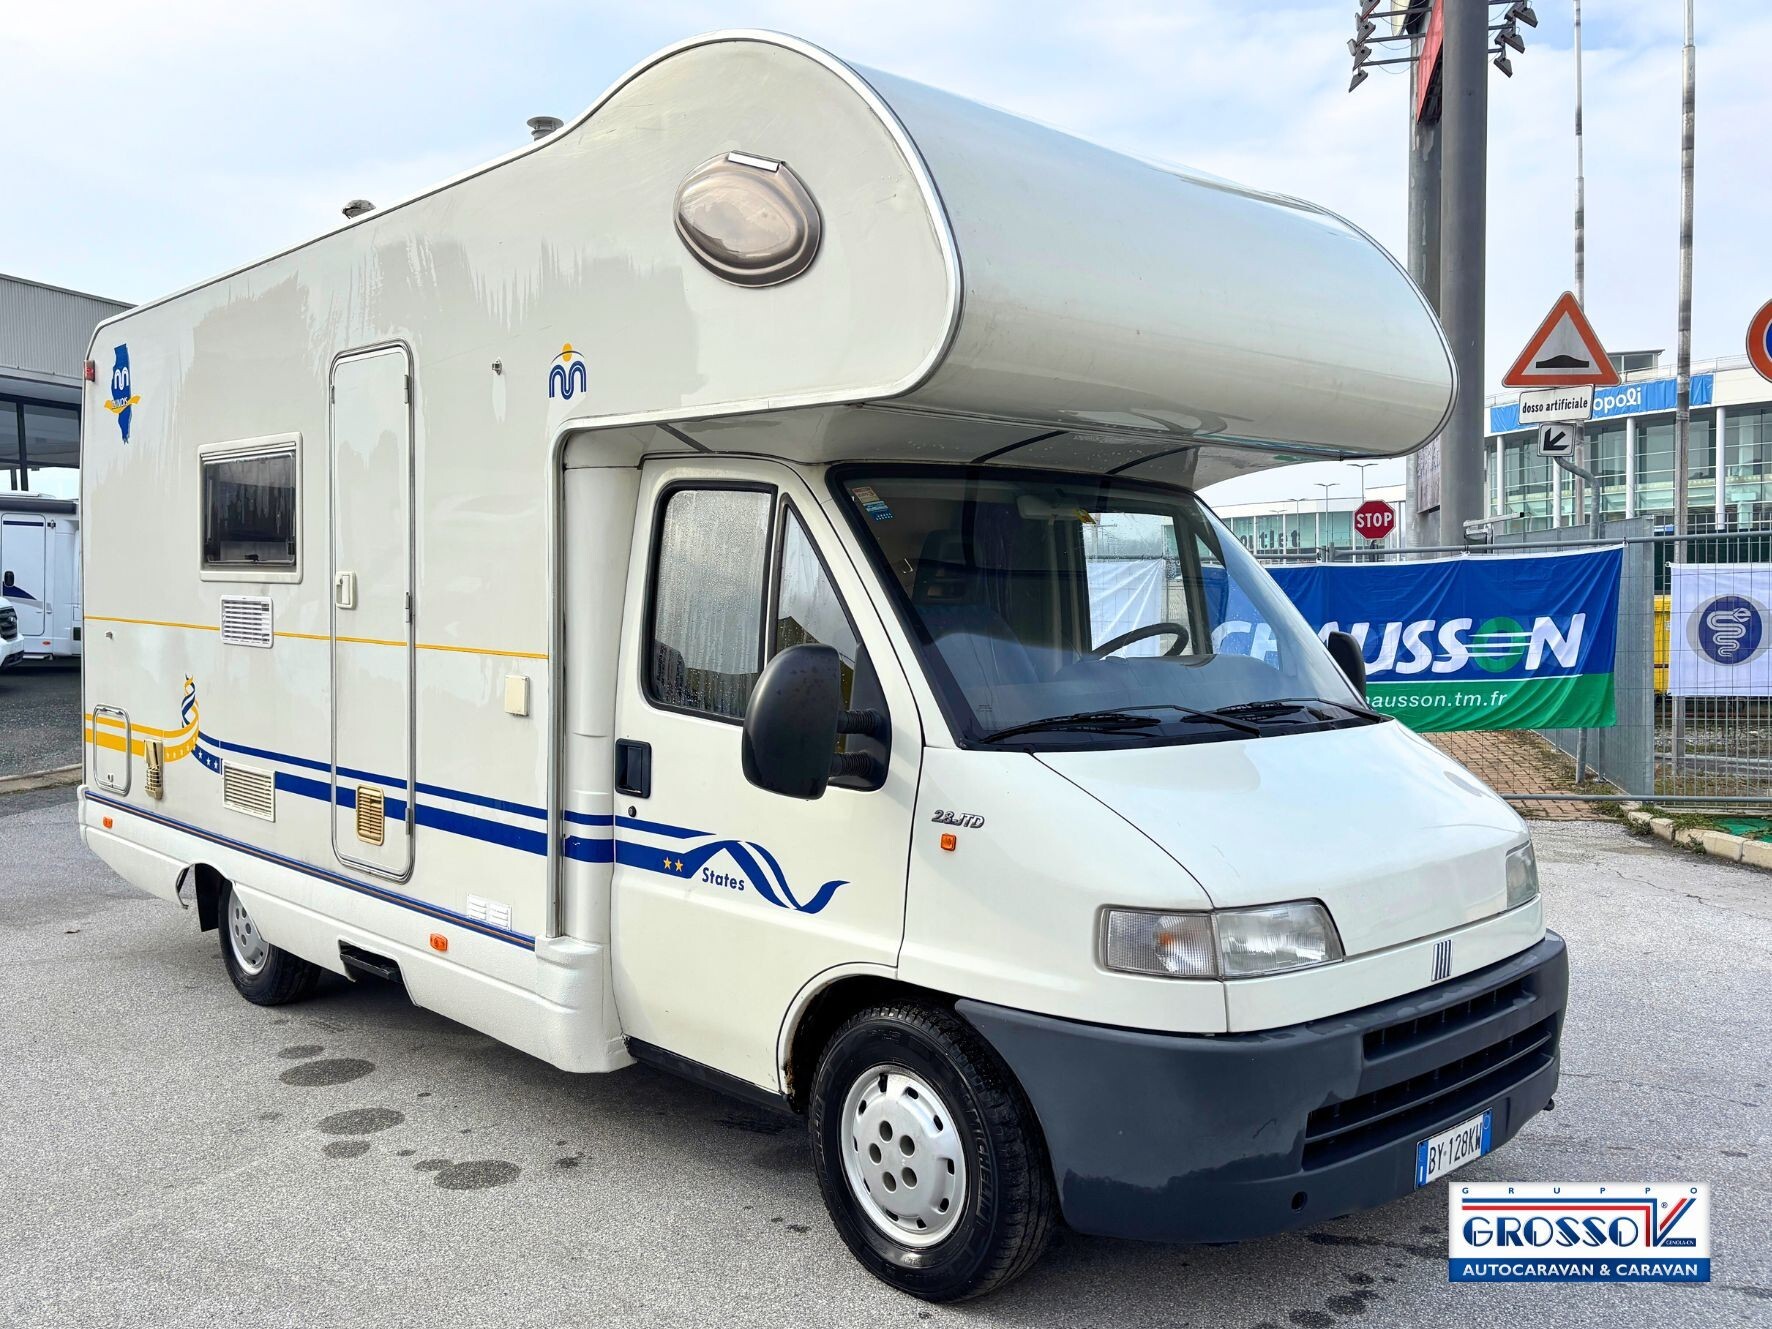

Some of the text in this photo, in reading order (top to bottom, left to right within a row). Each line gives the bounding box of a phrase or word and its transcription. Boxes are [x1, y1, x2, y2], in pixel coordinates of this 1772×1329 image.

[1522, 396, 1588, 414] dosso artificiale
[1593, 387, 1642, 414] opoli
[1356, 512, 1393, 528] STOP
[701, 866, 745, 891] States
